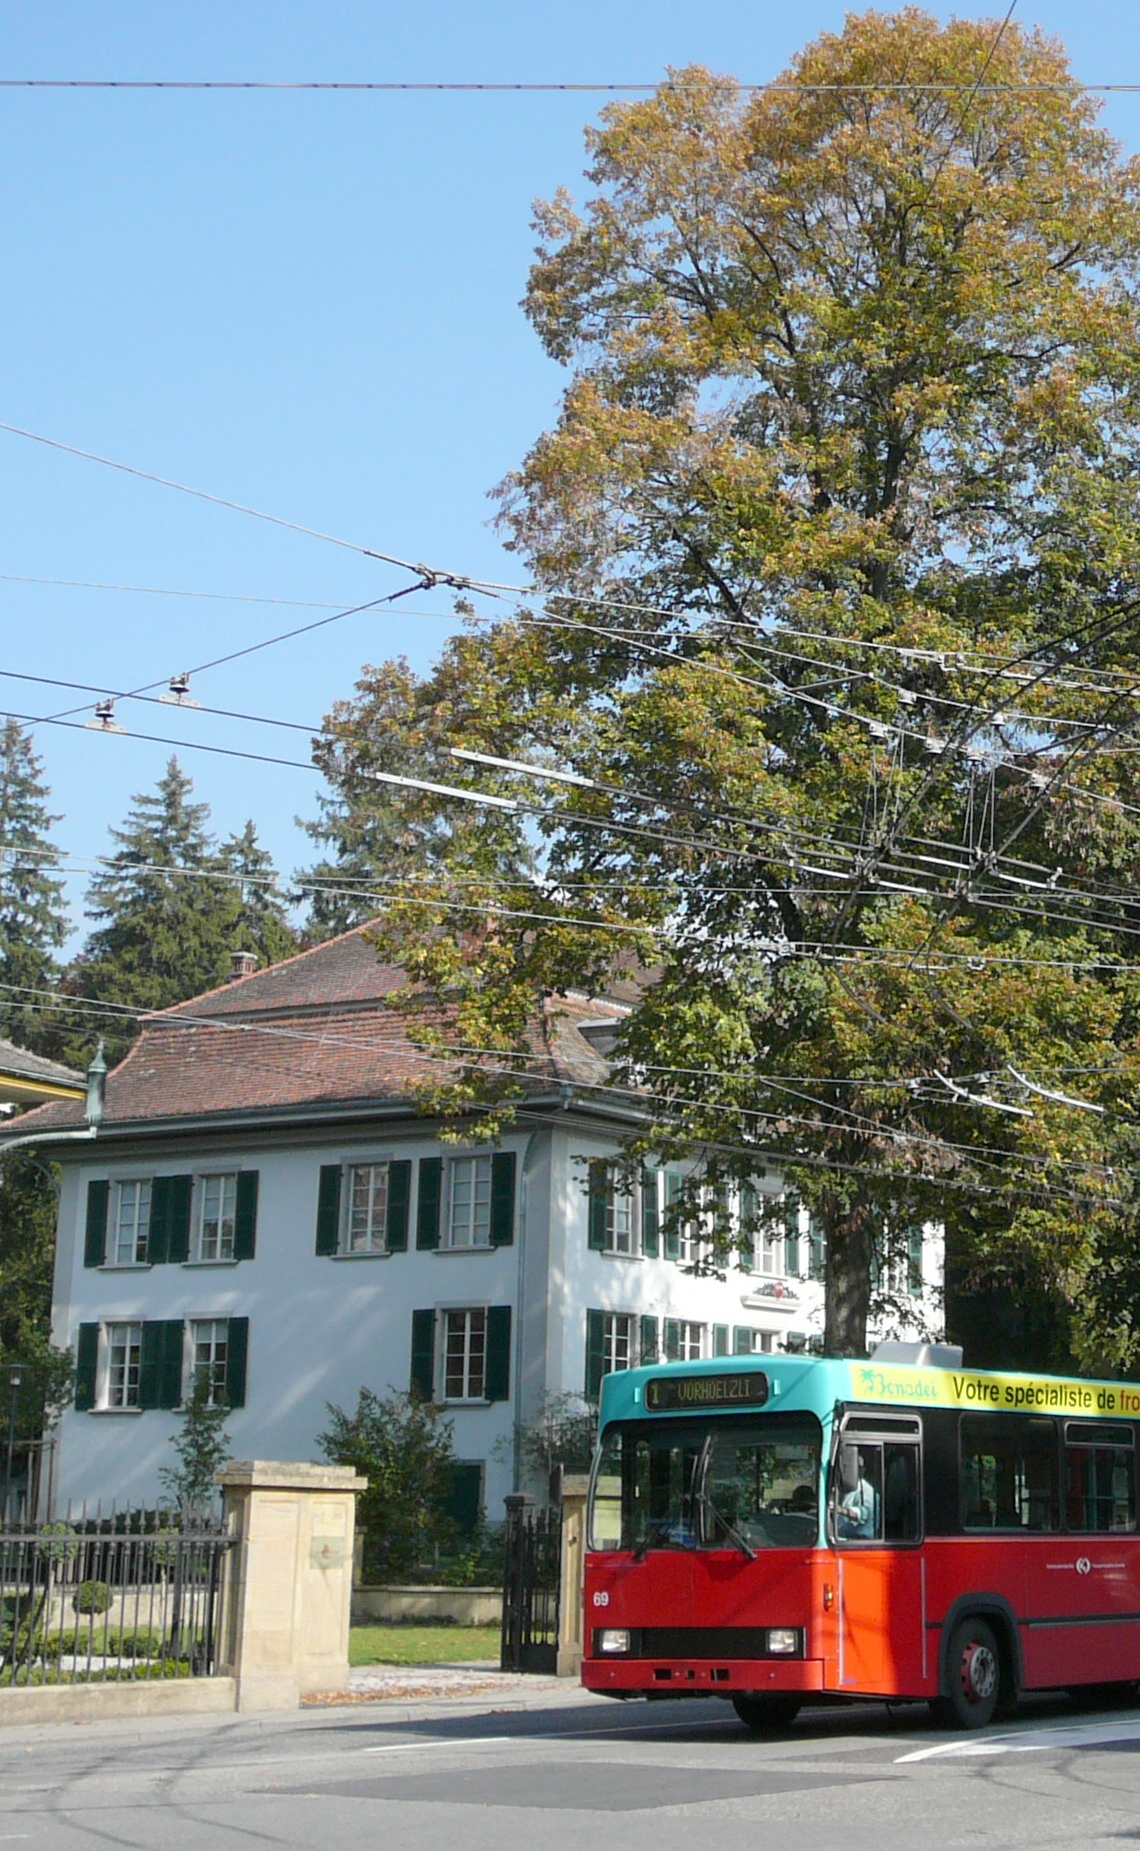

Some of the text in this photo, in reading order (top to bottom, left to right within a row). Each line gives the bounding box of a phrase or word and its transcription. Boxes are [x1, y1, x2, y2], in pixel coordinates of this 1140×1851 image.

[650, 1383, 660, 1404] 1
[953, 1377, 999, 1401] Votre
[1004, 1382, 1092, 1408] spécialiste
[1097, 1388, 1115, 1409] de
[593, 1591, 609, 1606] 69
